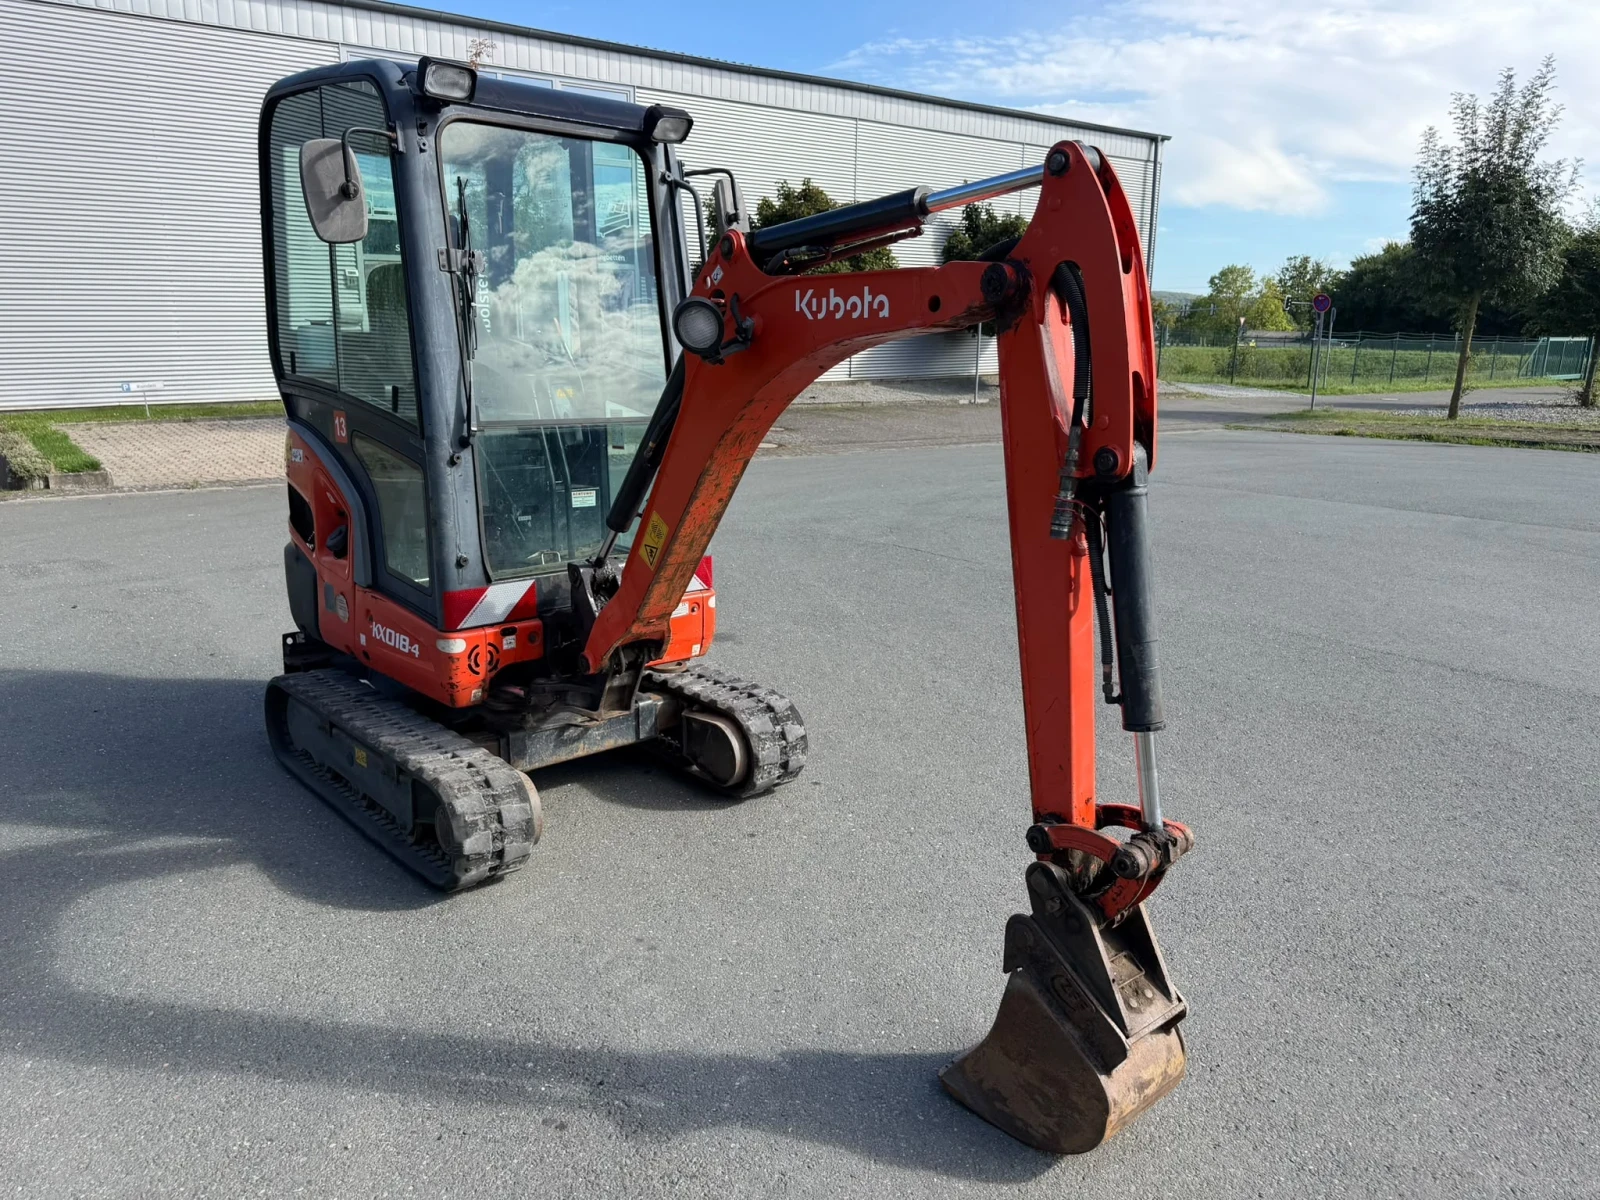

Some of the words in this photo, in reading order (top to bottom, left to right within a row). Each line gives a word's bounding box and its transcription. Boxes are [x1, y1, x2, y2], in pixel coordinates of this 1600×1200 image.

[795, 285, 890, 320] Kubota
[334, 416, 347, 437] 13
[372, 621, 420, 658] KX018-4
